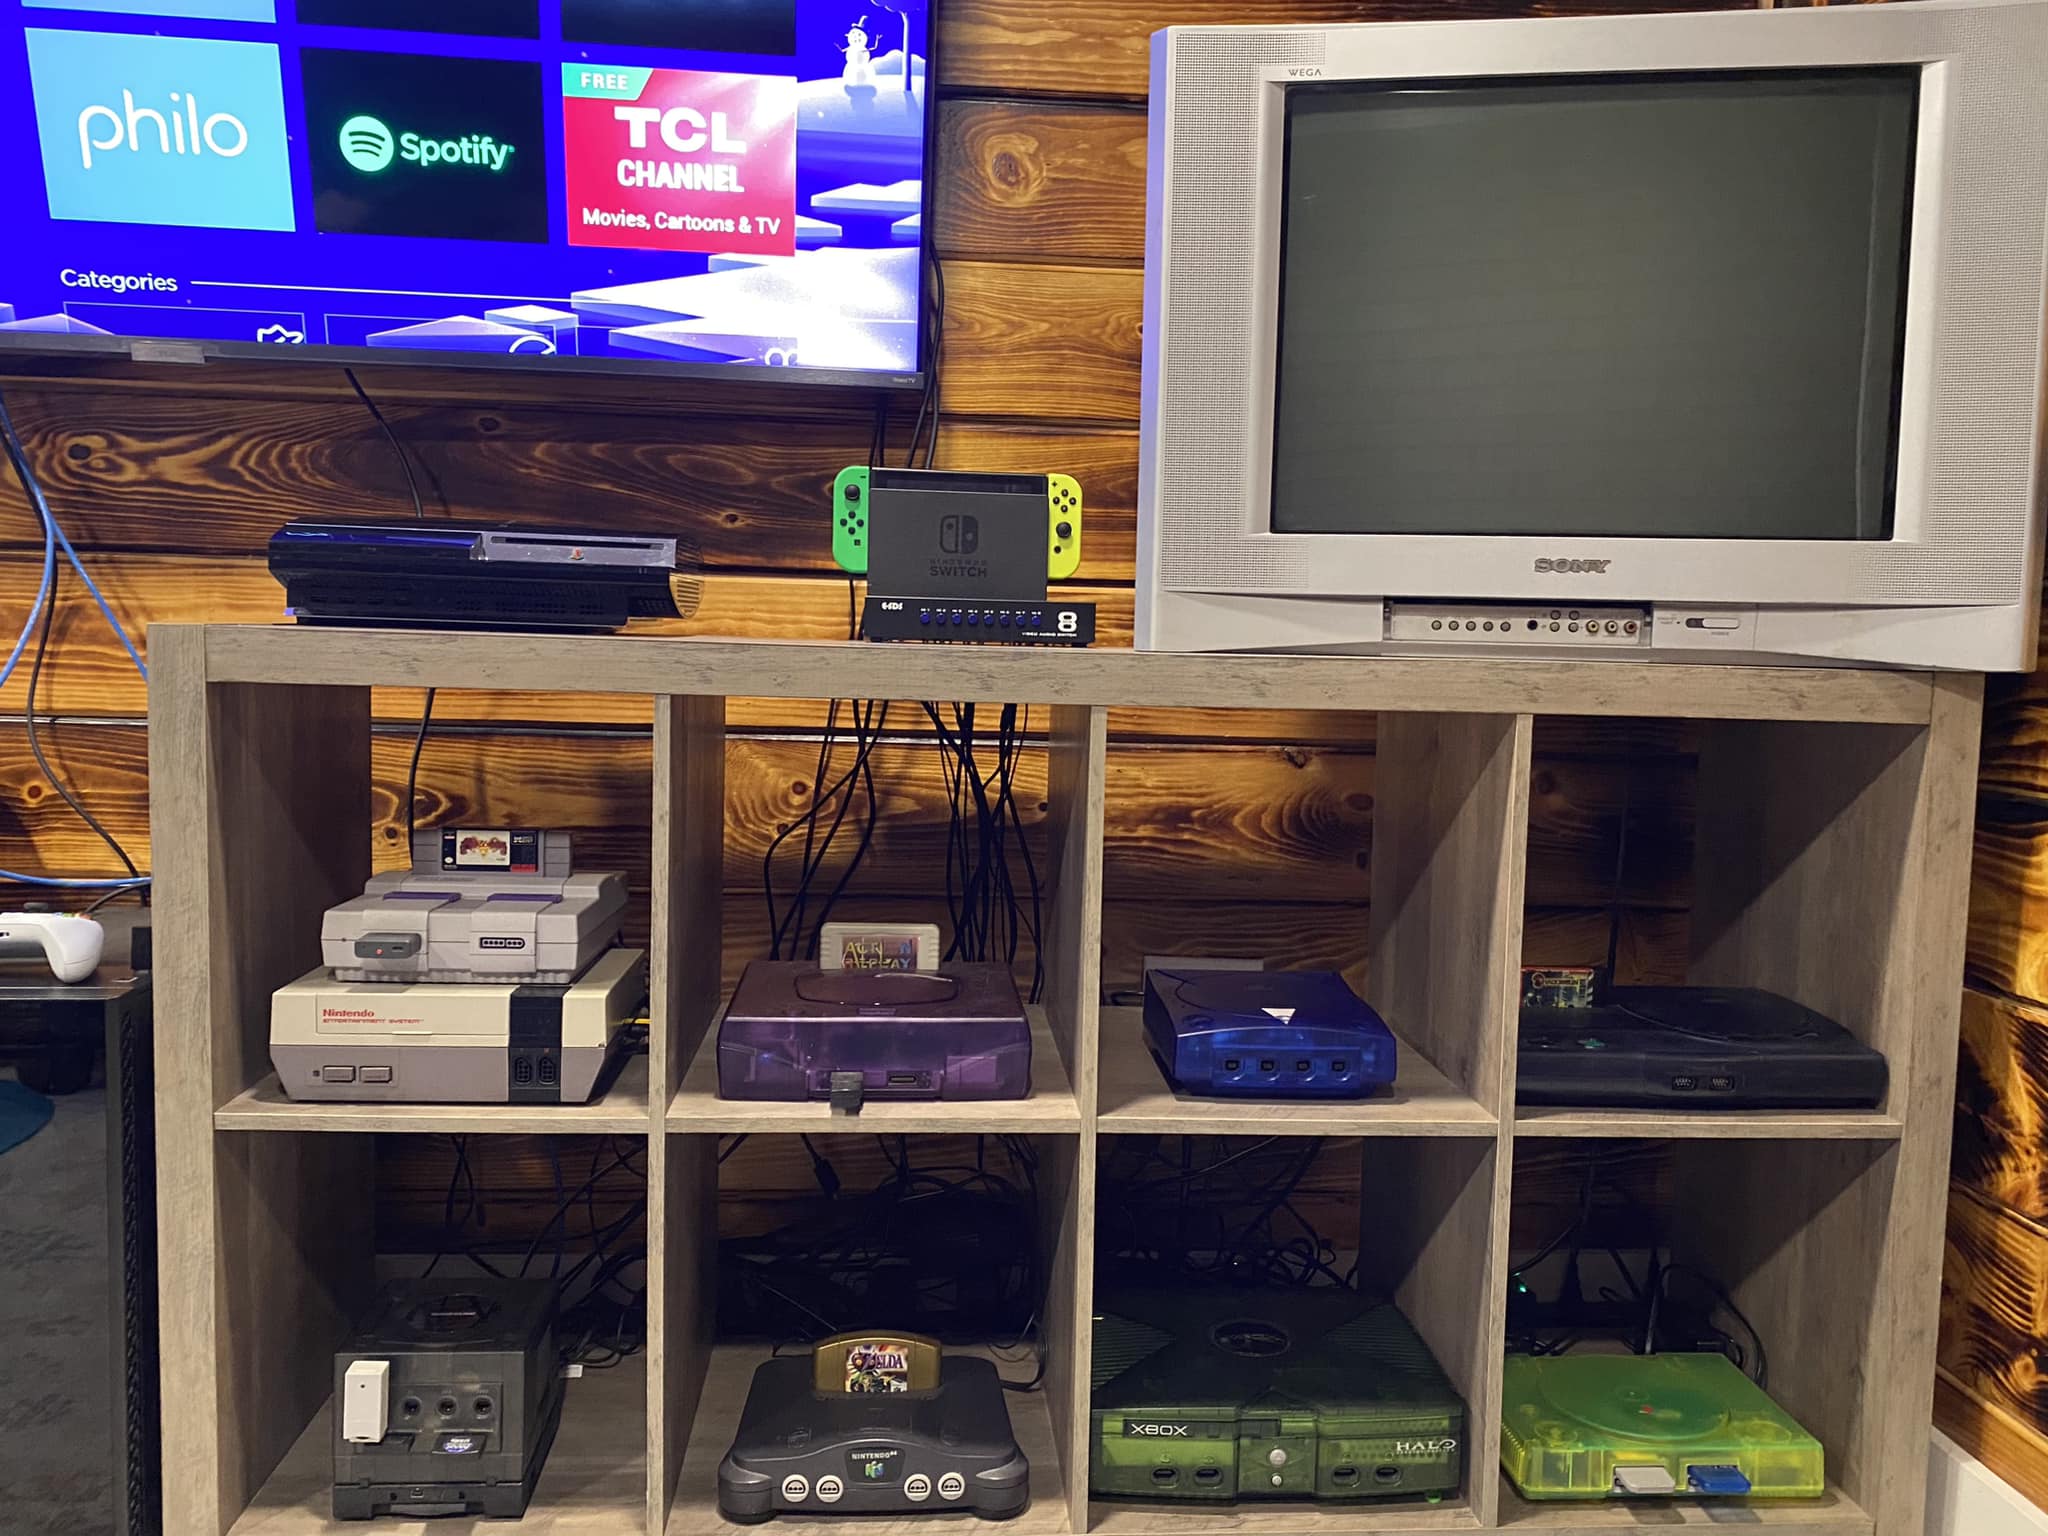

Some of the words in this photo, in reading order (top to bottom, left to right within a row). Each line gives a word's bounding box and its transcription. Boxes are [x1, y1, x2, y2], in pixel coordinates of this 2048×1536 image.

[580, 72, 629, 91] FREE
[1288, 68, 1322, 77] WEGA
[78, 88, 248, 169] philo
[613, 105, 747, 154] TCL
[399, 132, 509, 171] Spotify
[616, 158, 745, 193] CHANNEL
[582, 207, 651, 231] Movies,
[653, 211, 735, 234] Cartoons
[738, 215, 752, 234] &
[755, 216, 781, 235] TV
[59, 268, 179, 294] Categories
[929, 566, 988, 578] SWITCH
[1534, 558, 1612, 574] SONY
[1057, 611, 1078, 632] 8
[322, 1009, 375, 1018] Nintendo
[1131, 1423, 1188, 1436] XBOX
[1396, 1438, 1457, 1451] HALO
